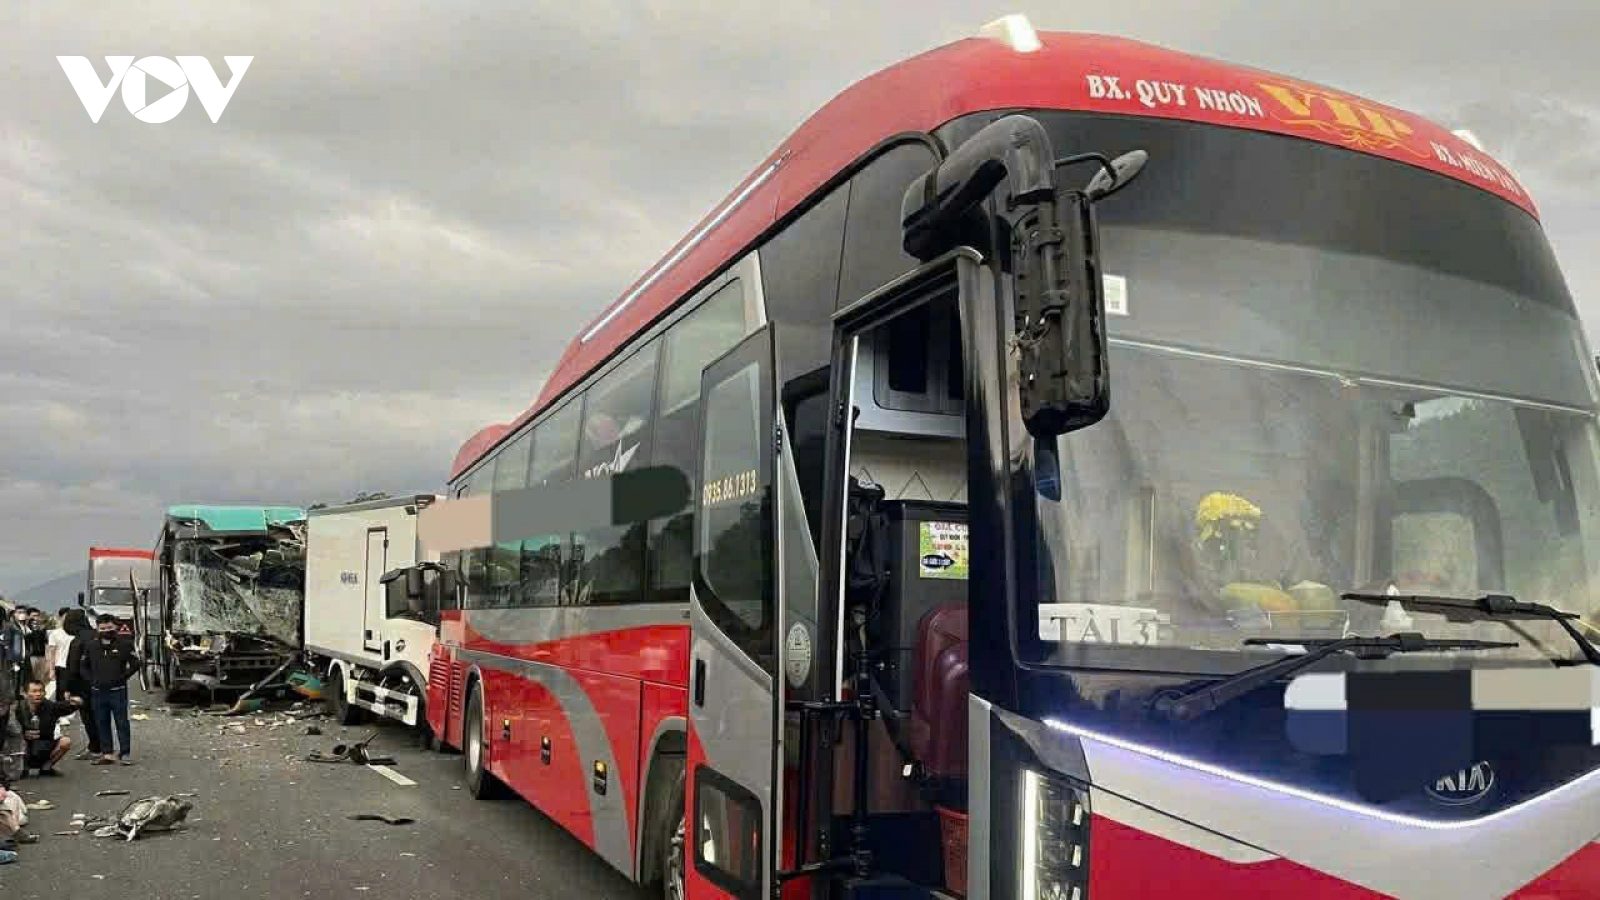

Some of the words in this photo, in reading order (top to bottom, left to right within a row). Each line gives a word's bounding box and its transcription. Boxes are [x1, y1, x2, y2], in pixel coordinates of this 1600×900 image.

[1086, 74, 1131, 100] BX.
[1135, 79, 1187, 108] QUY
[1195, 86, 1265, 117] NHƠN
[1259, 84, 1412, 139] VIP
[703, 469, 757, 506] 0935.86.1313
